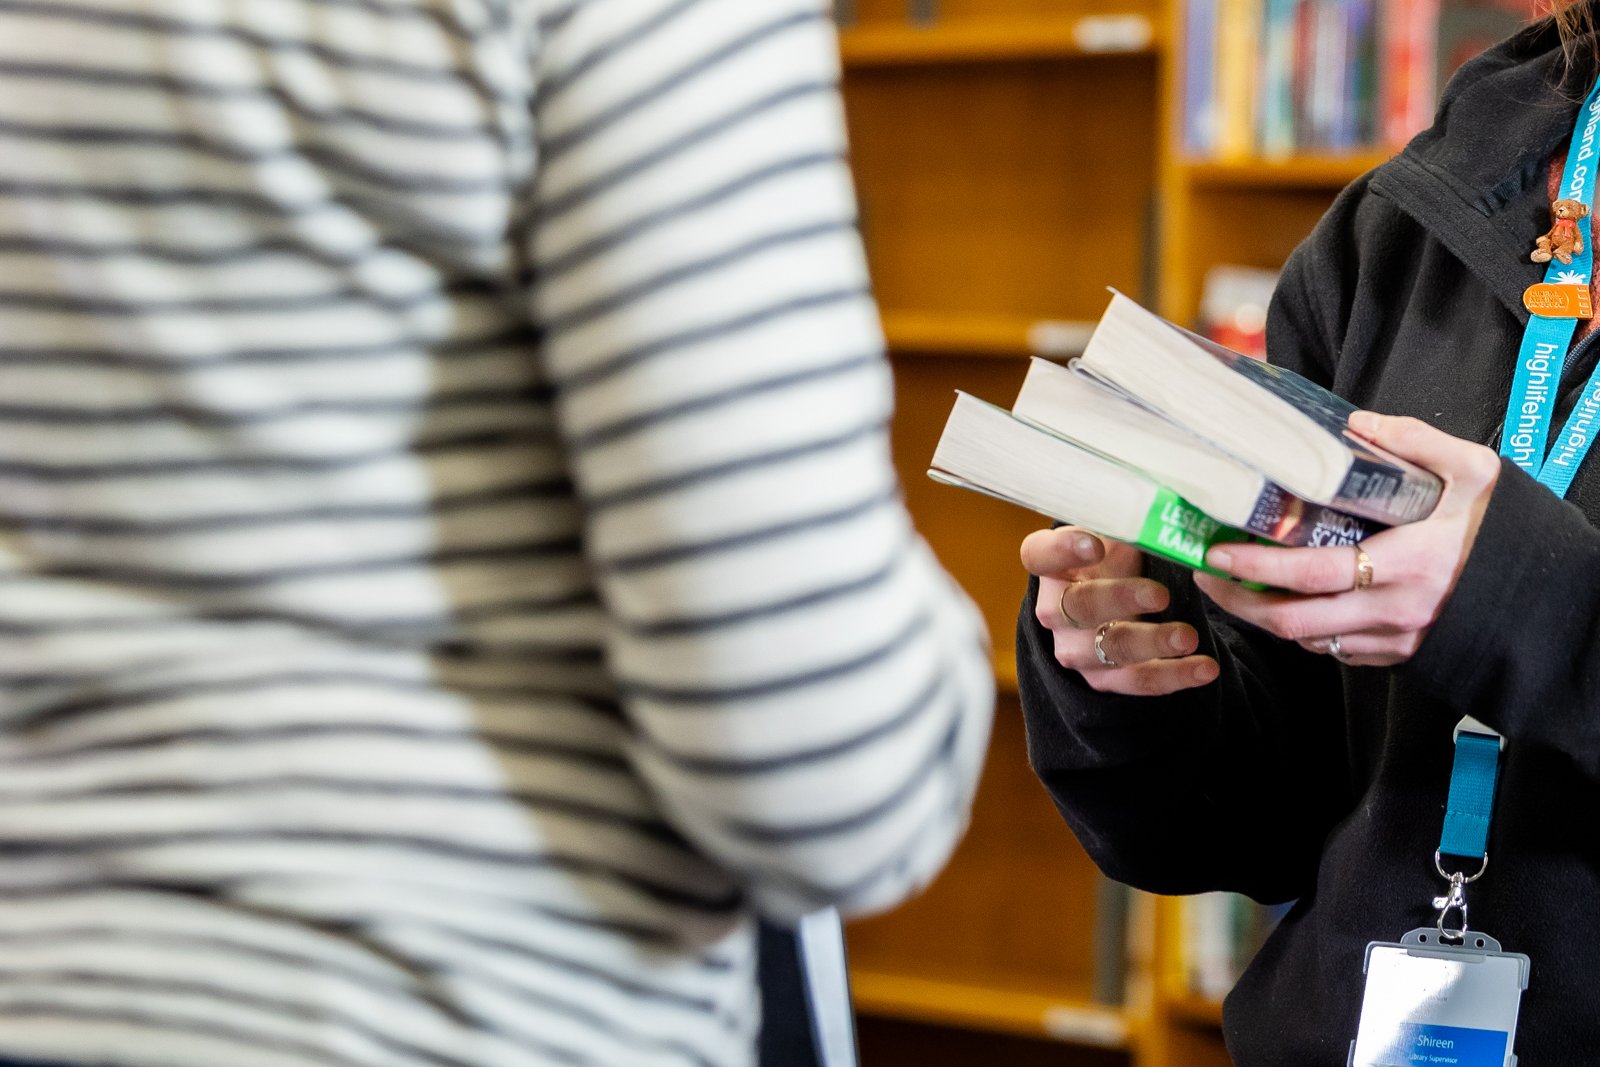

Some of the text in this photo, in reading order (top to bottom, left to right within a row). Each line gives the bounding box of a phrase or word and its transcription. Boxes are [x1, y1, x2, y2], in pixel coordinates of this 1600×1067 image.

[1159, 500, 1222, 537] LESLEY
[1315, 508, 1365, 541] SIMON
[1156, 524, 1205, 562] KARA
[1417, 1034, 1454, 1049] Shireen
